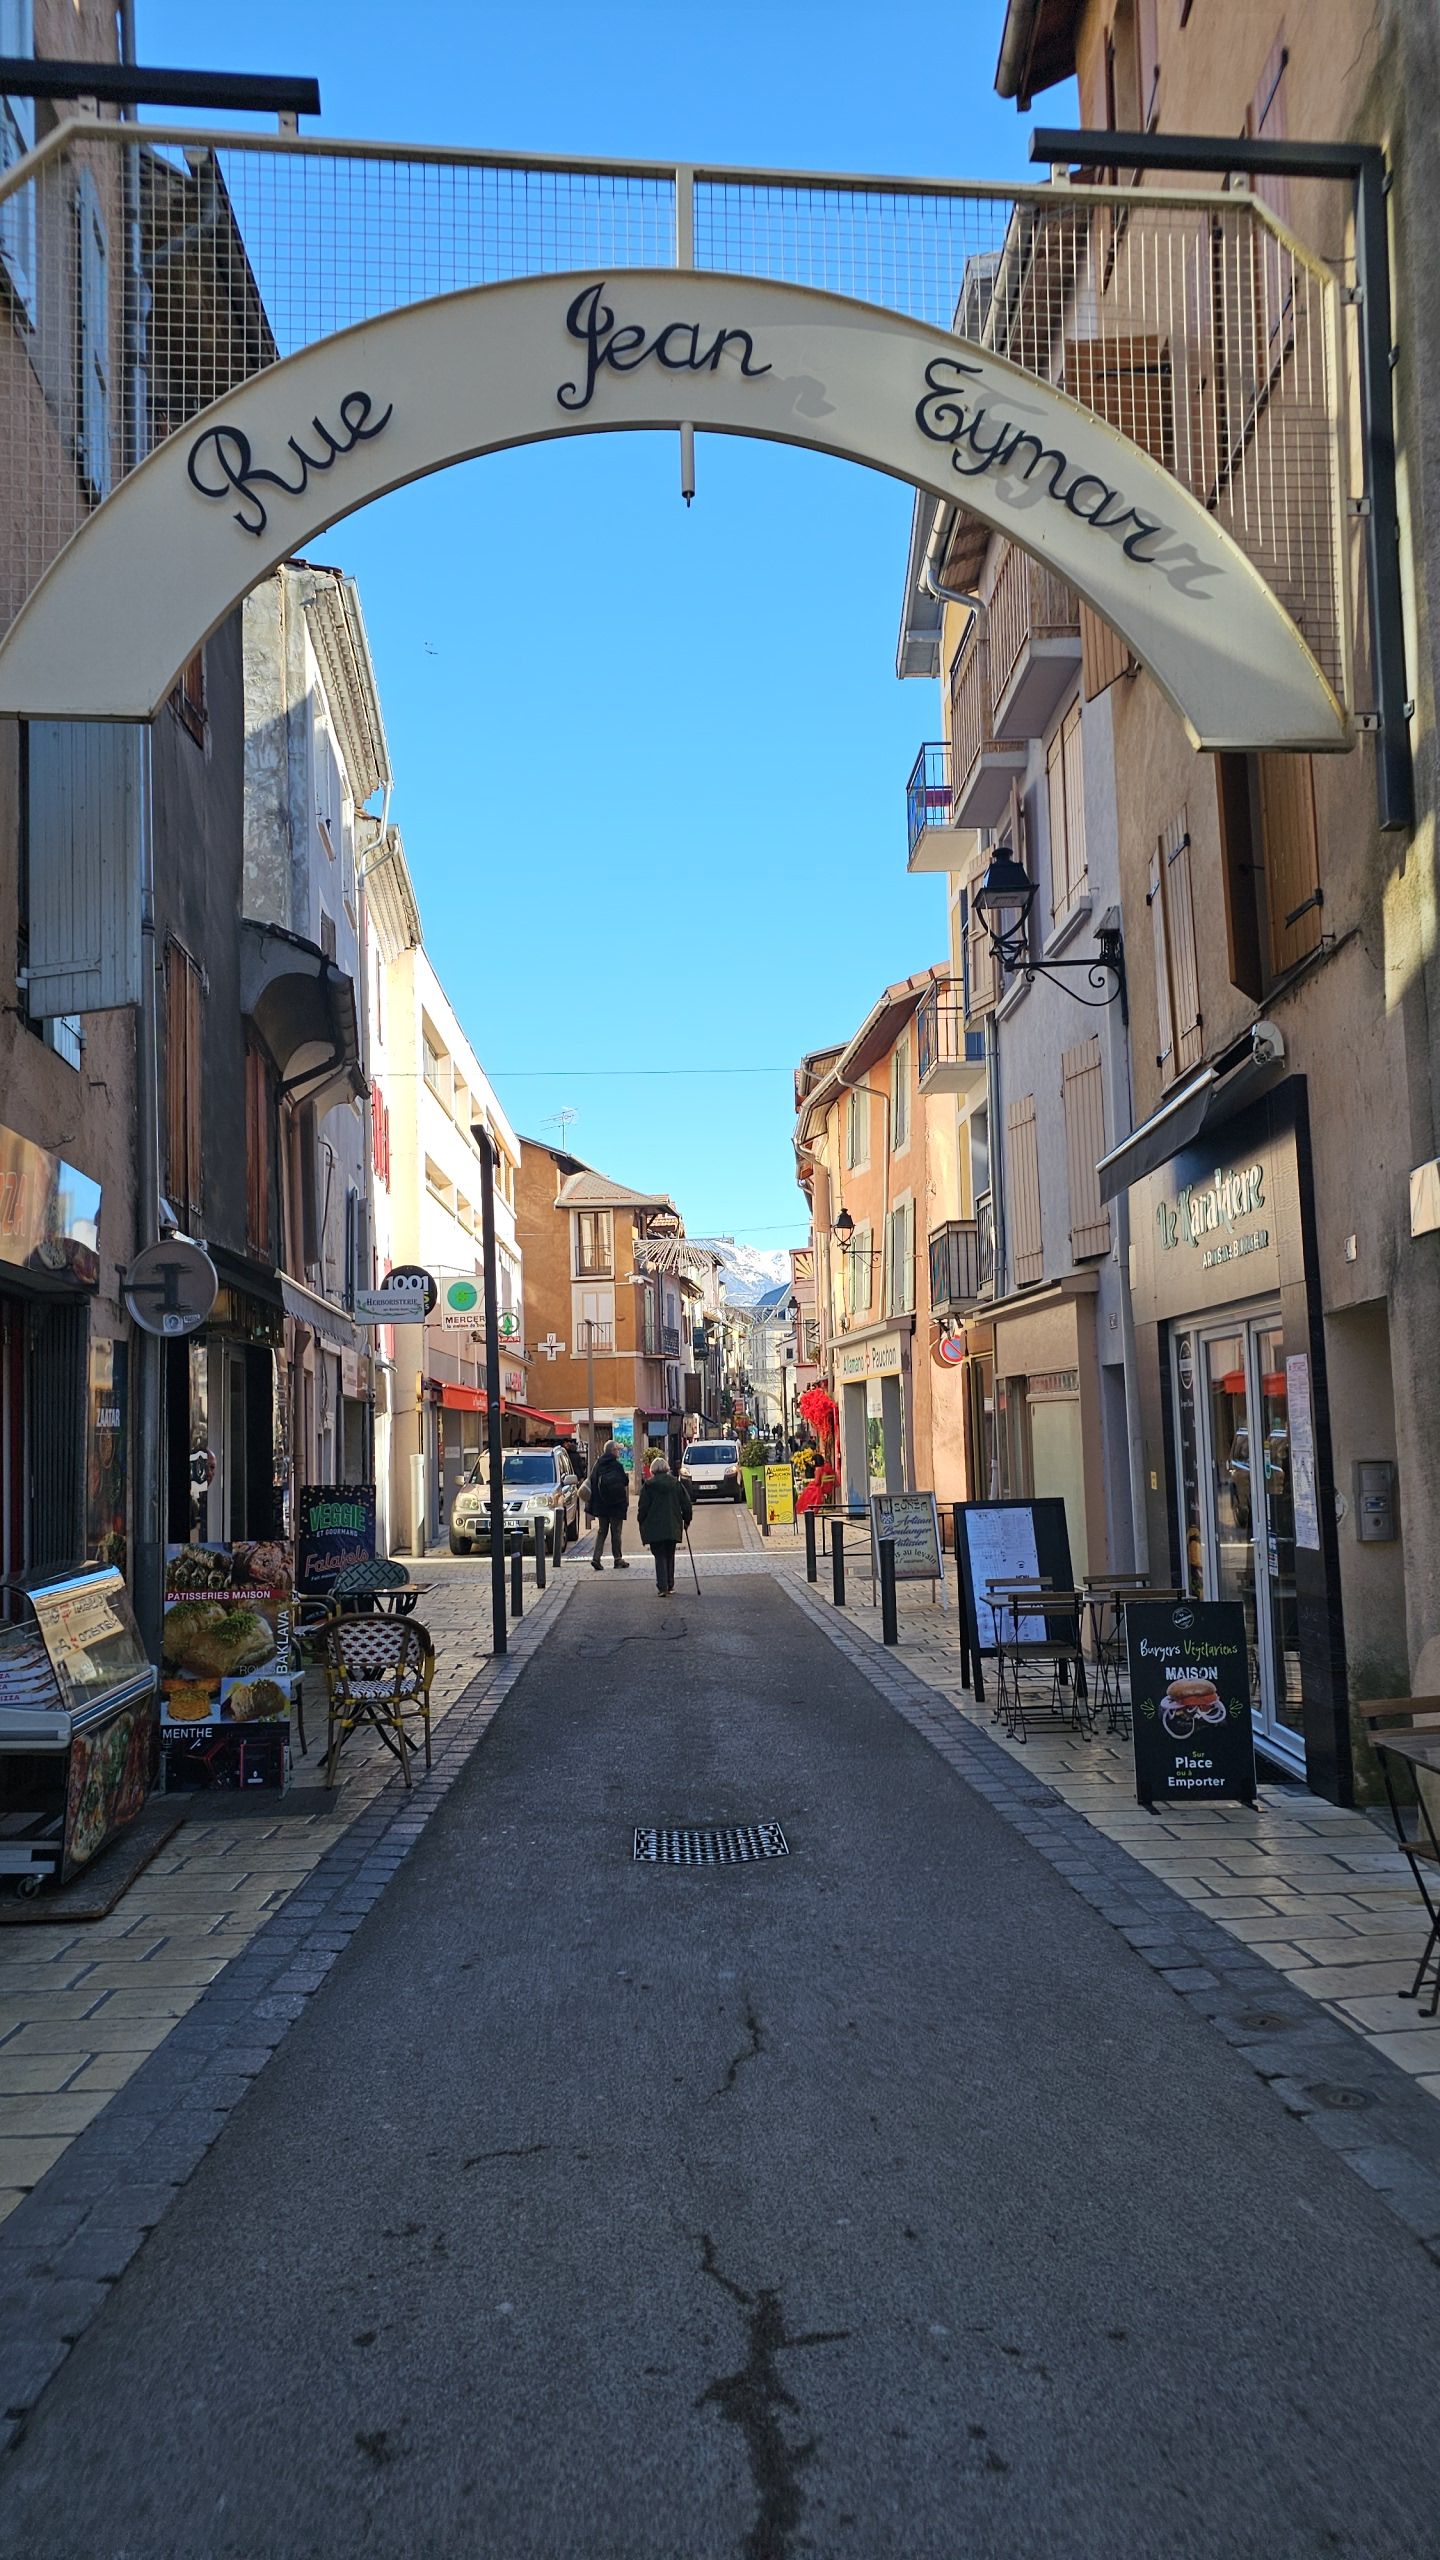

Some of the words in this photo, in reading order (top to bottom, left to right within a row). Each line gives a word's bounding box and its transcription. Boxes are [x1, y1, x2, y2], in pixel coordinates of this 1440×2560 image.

[187, 390, 393, 537] Rue
[557, 281, 772, 410] Jean
[915, 357, 1161, 563] Eymar
[386, 1275, 429, 1291] 1001
[445, 1316, 485, 1324] MERCER
[96, 1408, 120, 1427] ZAATAR
[309, 1503, 366, 1532] VEGGIE
[894, 1514, 931, 1527] Artisan
[880, 1525, 931, 1539] Boulanger
[304, 1544, 370, 1577] Falafels
[167, 1592, 229, 1600] PATISSERIES
[232, 1591, 271, 1599] MAISON
[277, 1610, 290, 1674] BAKLAVA
[1140, 1638, 1181, 1662] Burgers
[1183, 1639, 1238, 1661] Végétariens
[1165, 1667, 1218, 1680] MAISON
[162, 1727, 213, 1739] MENTHE
[1175, 1756, 1213, 1769] Place
[1167, 1776, 1226, 1789] Emporter
